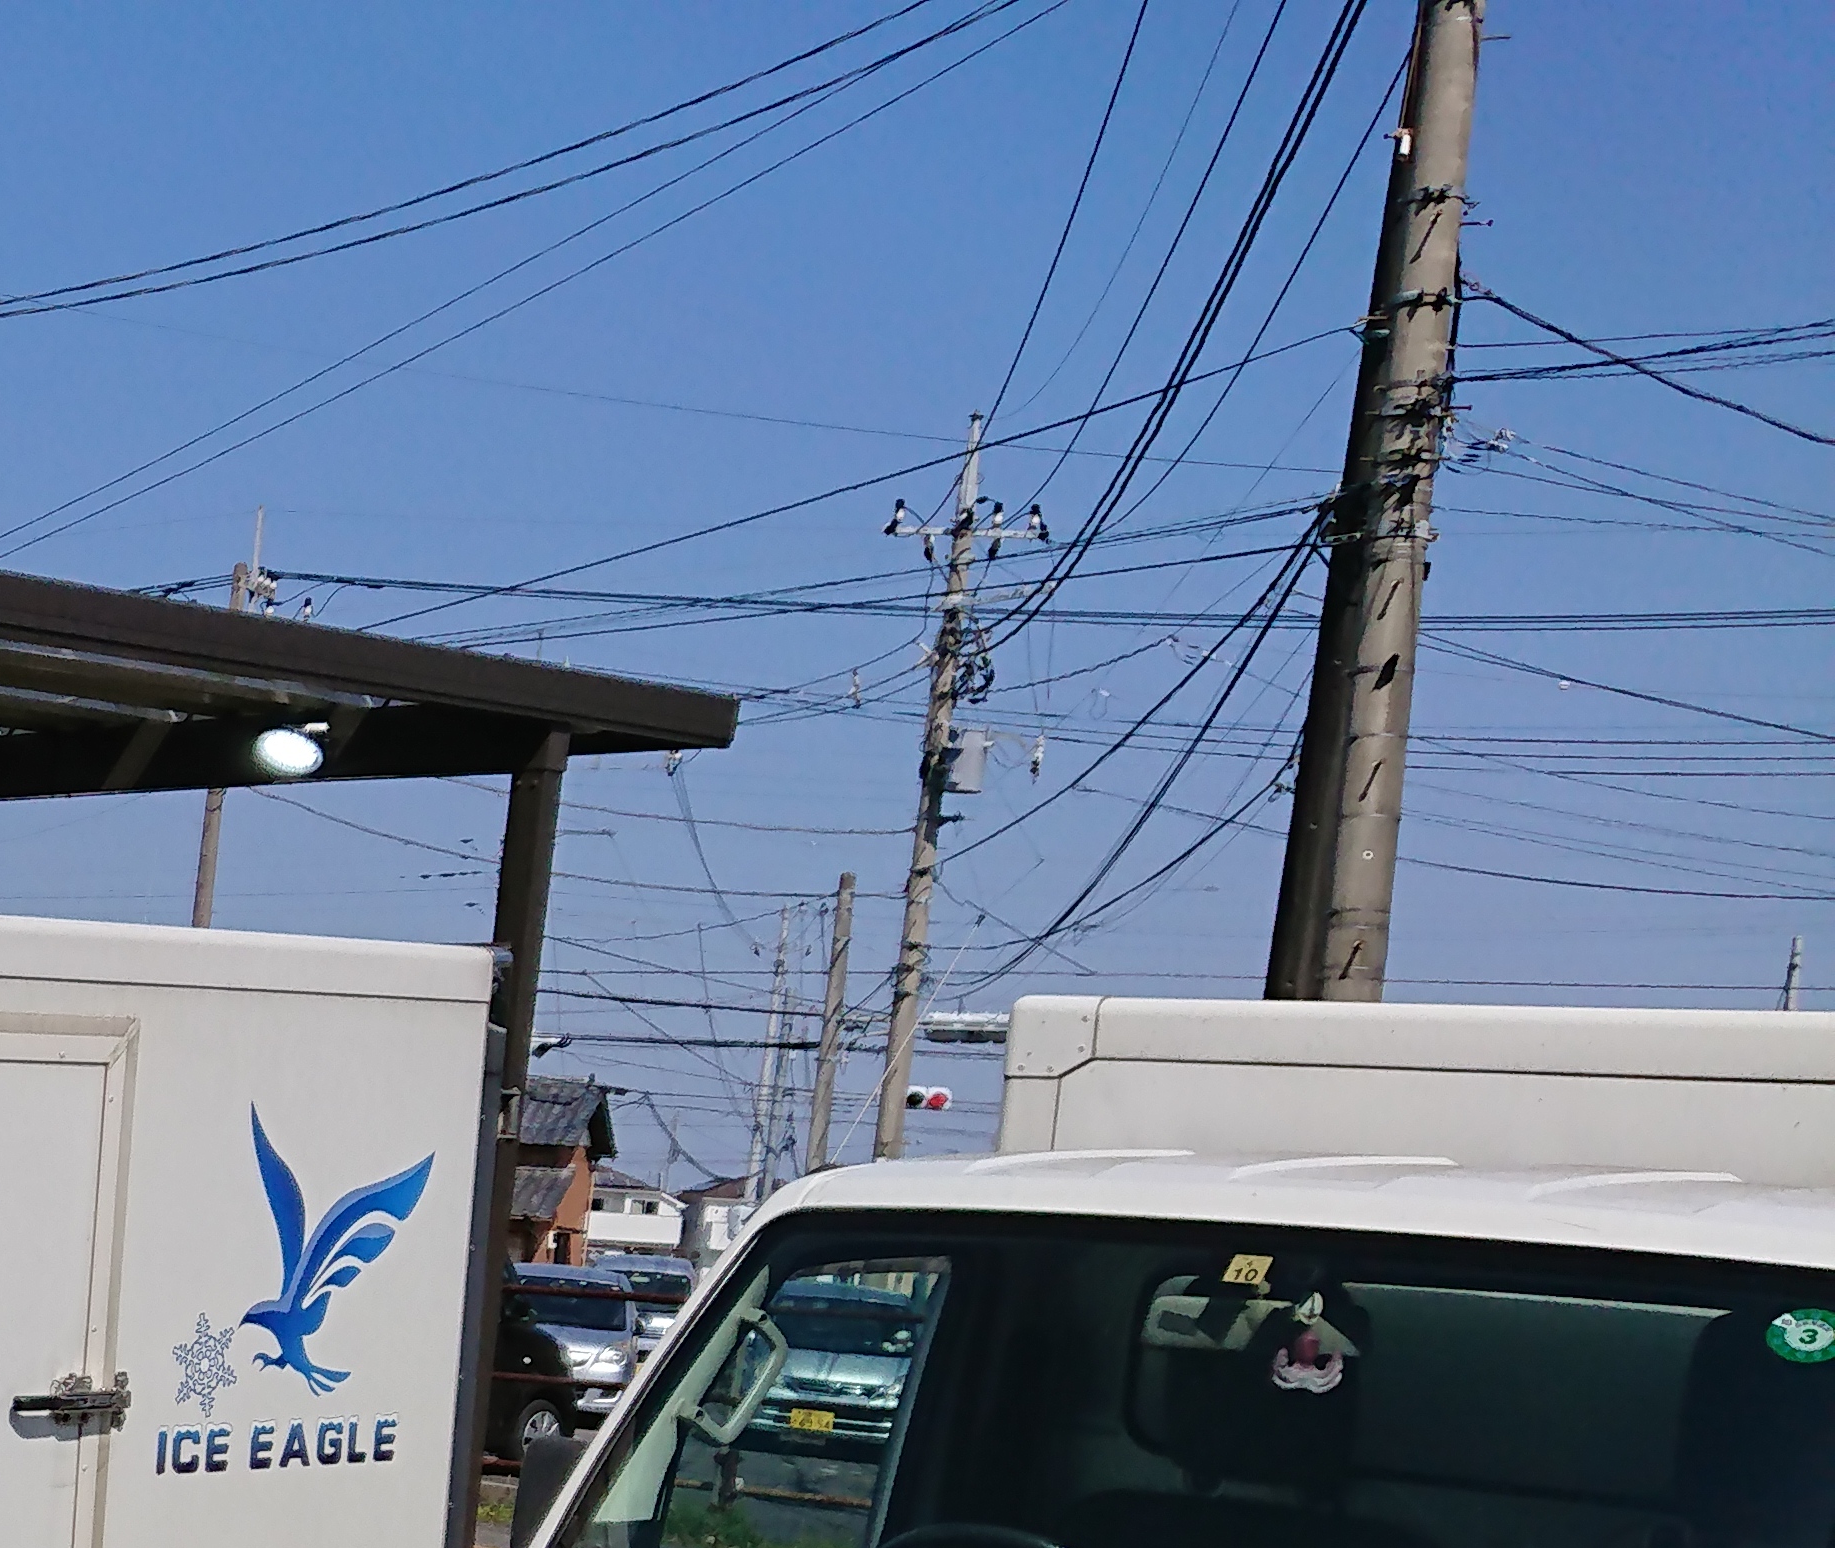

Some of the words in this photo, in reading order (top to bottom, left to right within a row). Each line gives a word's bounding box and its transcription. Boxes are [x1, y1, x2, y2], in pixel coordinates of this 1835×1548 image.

[1233, 1267, 1259, 1282] 10
[1798, 1328, 1819, 1345] 3
[155, 1423, 232, 1476] ICE
[249, 1412, 399, 1471] EAGLE
